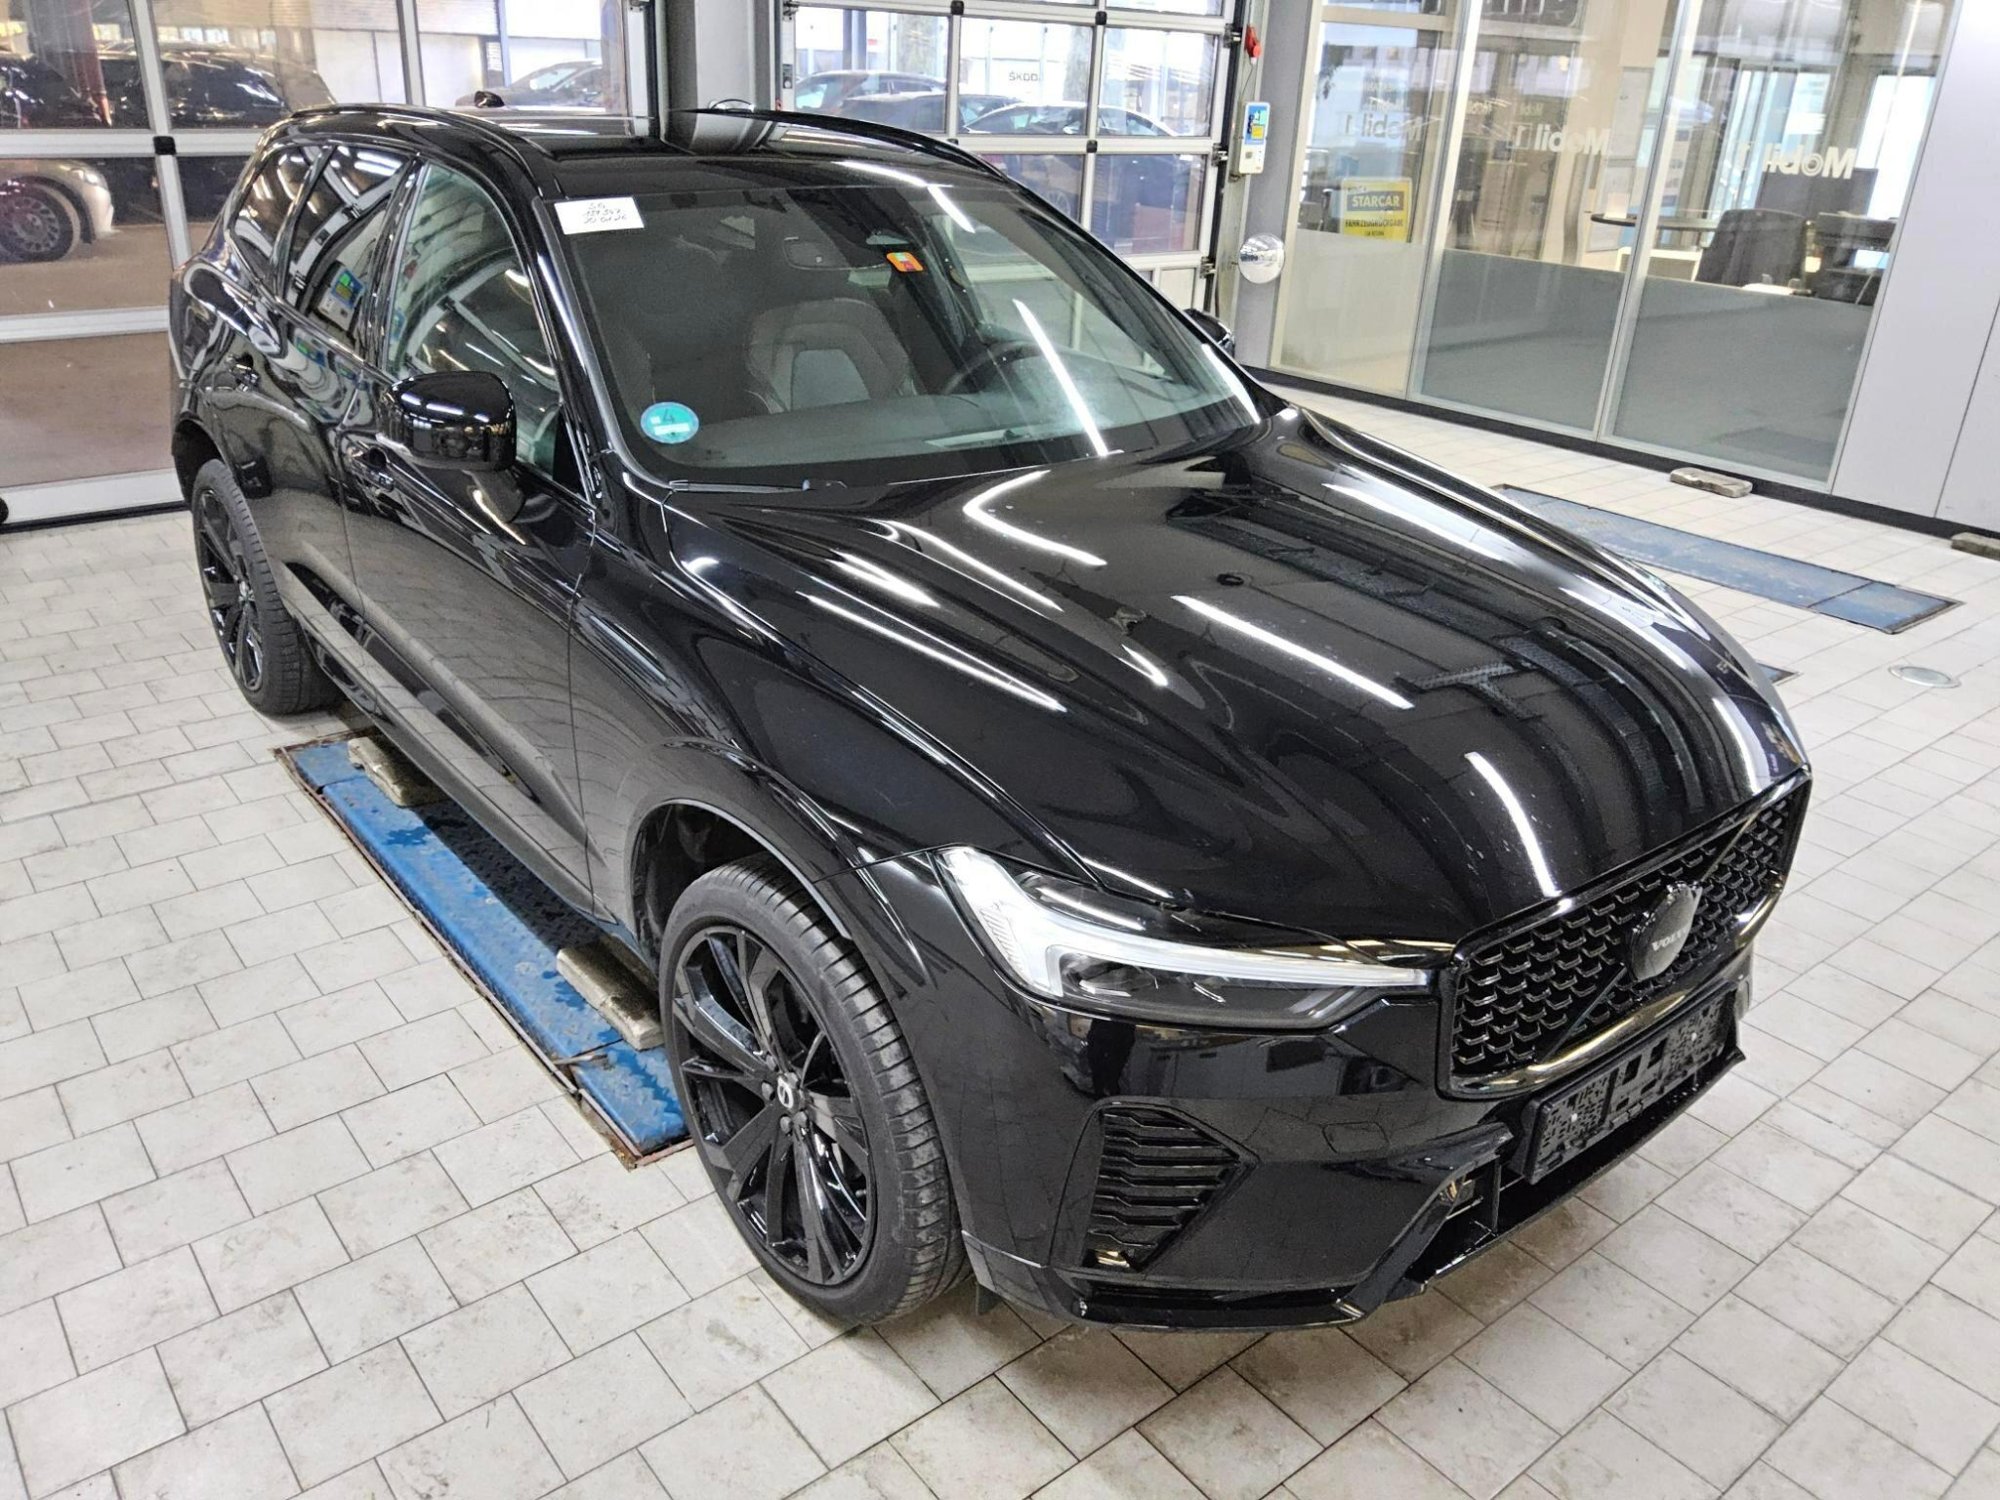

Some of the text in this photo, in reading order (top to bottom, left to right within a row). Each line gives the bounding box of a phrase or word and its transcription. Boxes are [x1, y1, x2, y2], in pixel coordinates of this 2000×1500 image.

[1008, 70, 1041, 82] ŠKOD
[1351, 194, 1401, 208] STARCAR
[662, 408, 675, 424] 4
